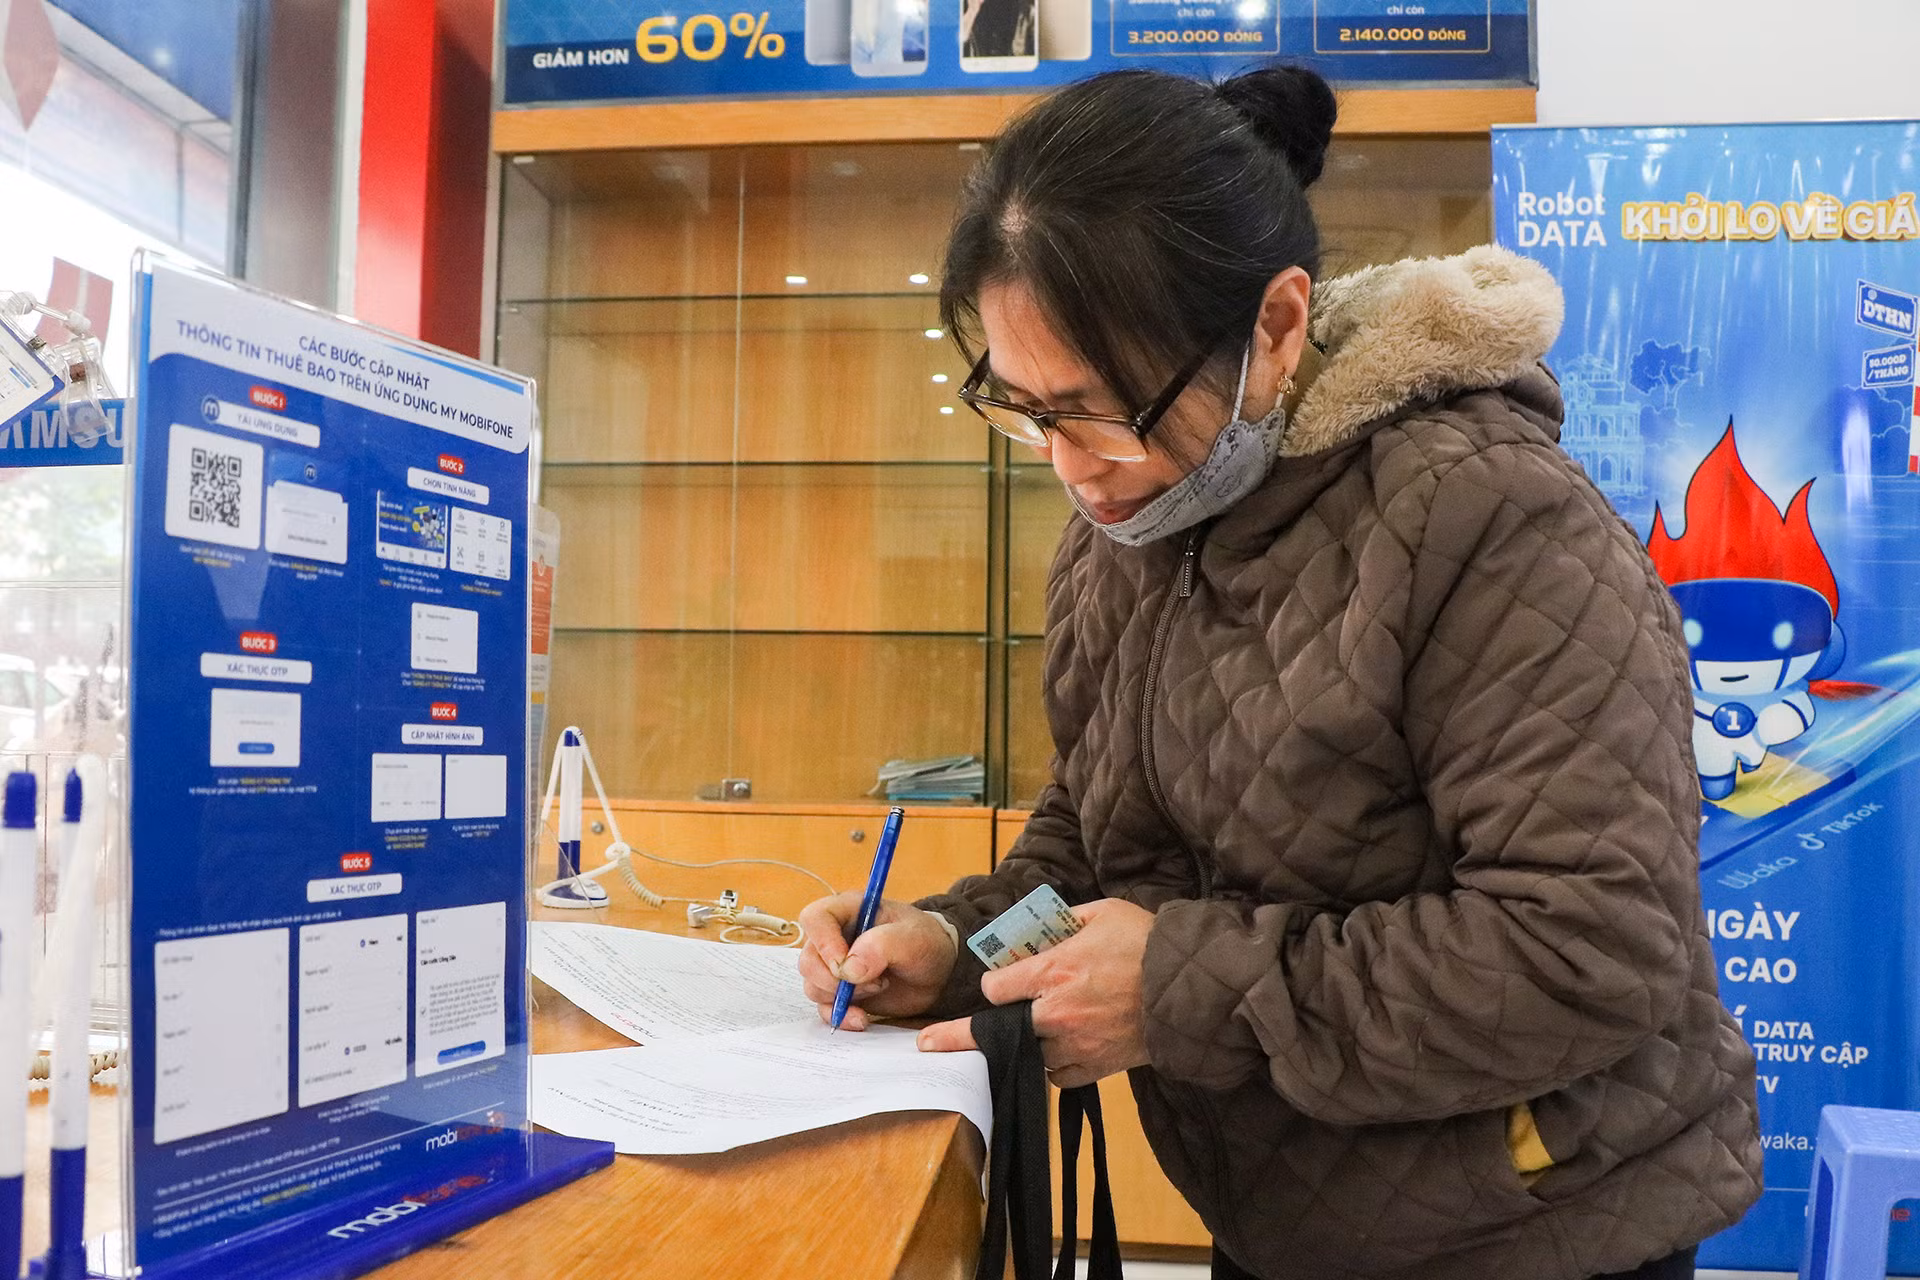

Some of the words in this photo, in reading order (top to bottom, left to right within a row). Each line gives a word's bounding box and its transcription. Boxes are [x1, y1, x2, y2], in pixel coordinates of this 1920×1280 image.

[533, 48, 583, 69] GIẢM
[588, 47, 629, 66] HƠN
[635, 11, 786, 64] 60%
[1128, 30, 1219, 44] 3.200.000
[1339, 28, 1424, 41] 2.140.000
[1518, 191, 1605, 216] Robot
[1727, 203, 1779, 238] LO
[1847, 194, 1918, 237] GIÁ
[1518, 220, 1607, 247] DATA
[299, 335, 327, 357] CÁC
[331, 346, 366, 370] BƯỚC
[369, 360, 393, 381] CẬP
[397, 370, 430, 391] NHẬT
[177, 320, 232, 351] THÔNG
[236, 339, 260, 359] TIN
[265, 348, 303, 373] THUÊ
[307, 362, 336, 382] BAO
[340, 371, 370, 393] TRÊN
[375, 381, 400, 403] ỨNG
[403, 393, 437, 415] DỤNG
[441, 404, 457, 420] MY
[460, 410, 513, 439] MOBIFONE
[271, 666, 288, 677] OTP
[1727, 711, 1741, 730] 1
[1821, 802, 1883, 834] TikTok
[1717, 856, 1799, 889] Waka
[367, 881, 382, 892] OTP
[1724, 956, 1797, 984] CAO
[1754, 1020, 1814, 1040] DATA
[1753, 1043, 1815, 1062] TRUY
[1820, 1041, 1869, 1069] CẬP
[1756, 1075, 1779, 1094] V
